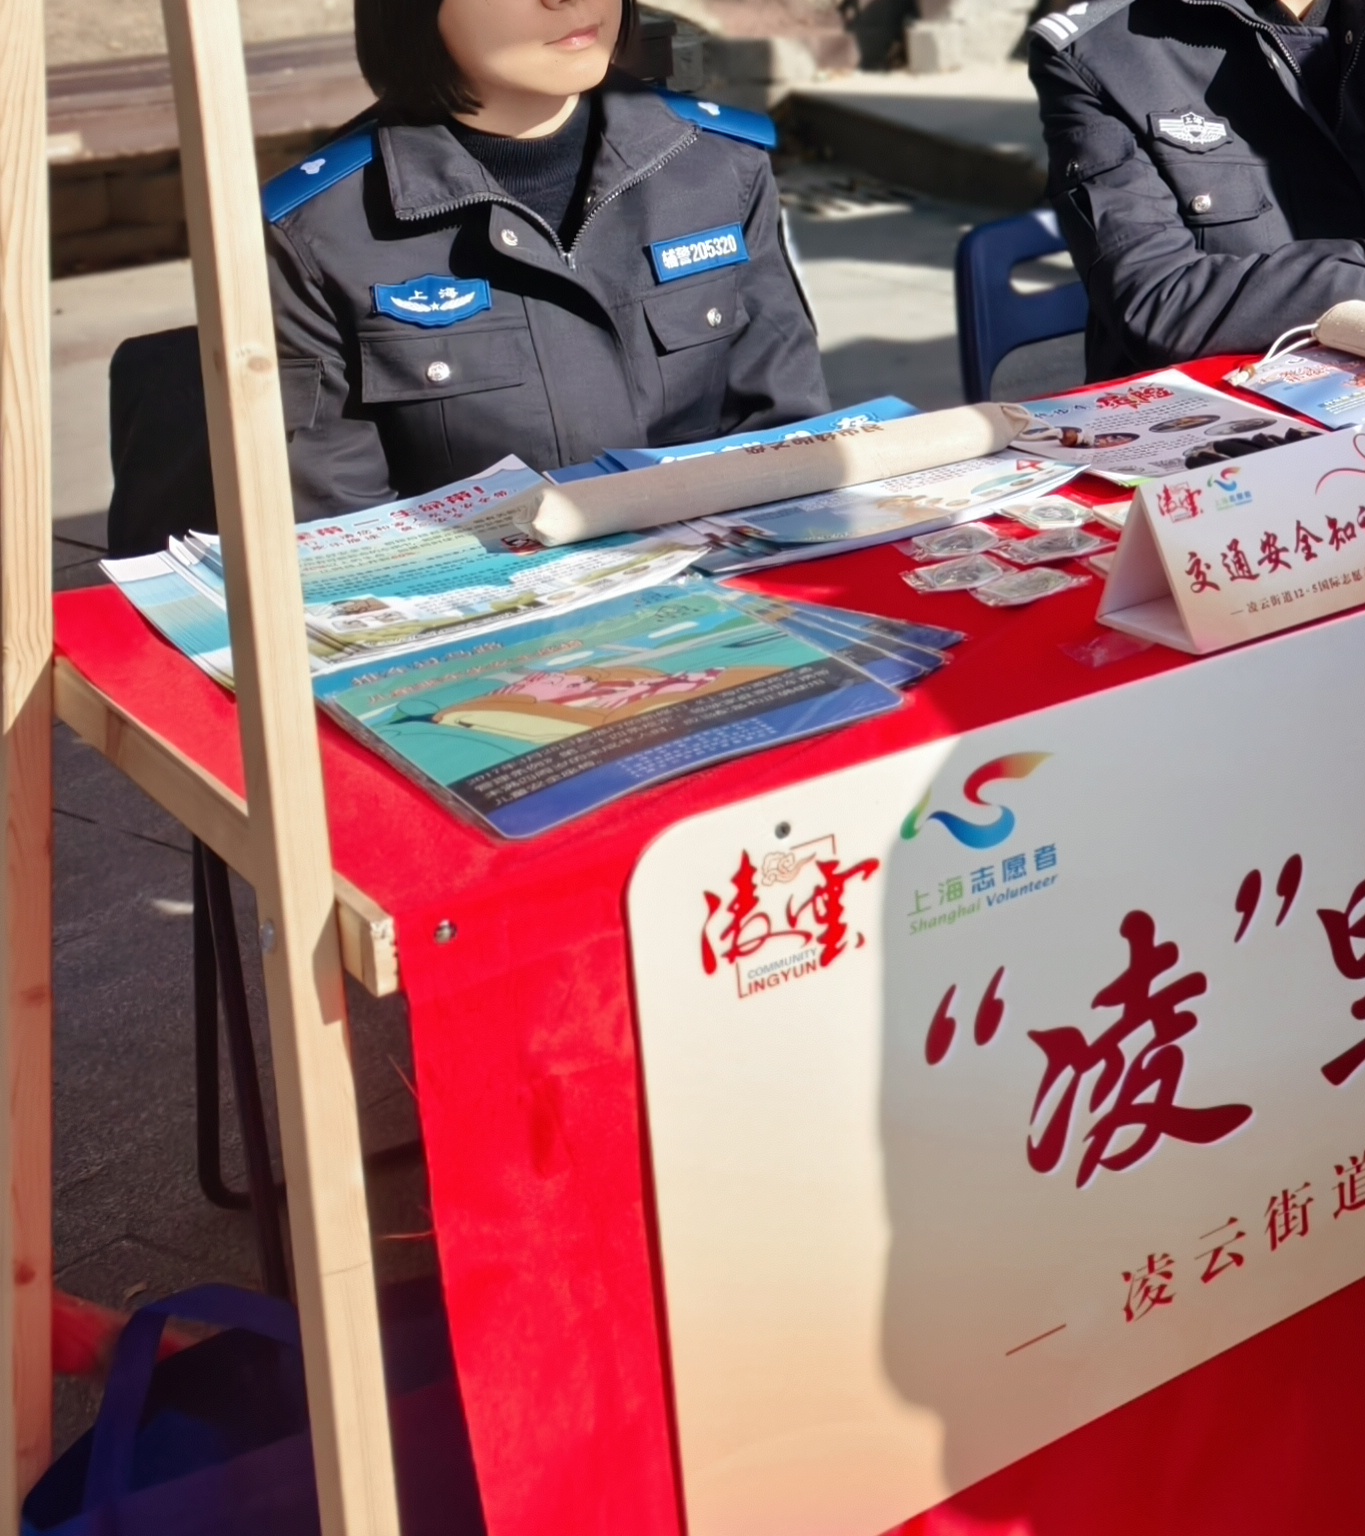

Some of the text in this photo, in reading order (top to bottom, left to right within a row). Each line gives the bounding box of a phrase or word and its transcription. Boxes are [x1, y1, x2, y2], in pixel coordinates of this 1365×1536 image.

[661, 234, 739, 271] 辅警205320
[407, 285, 459, 302] 上海
[906, 841, 1060, 917] 上海志愿者
[908, 873, 1059, 936] Shanghai Volunteer
[746, 948, 818, 981] COMMUNITY
